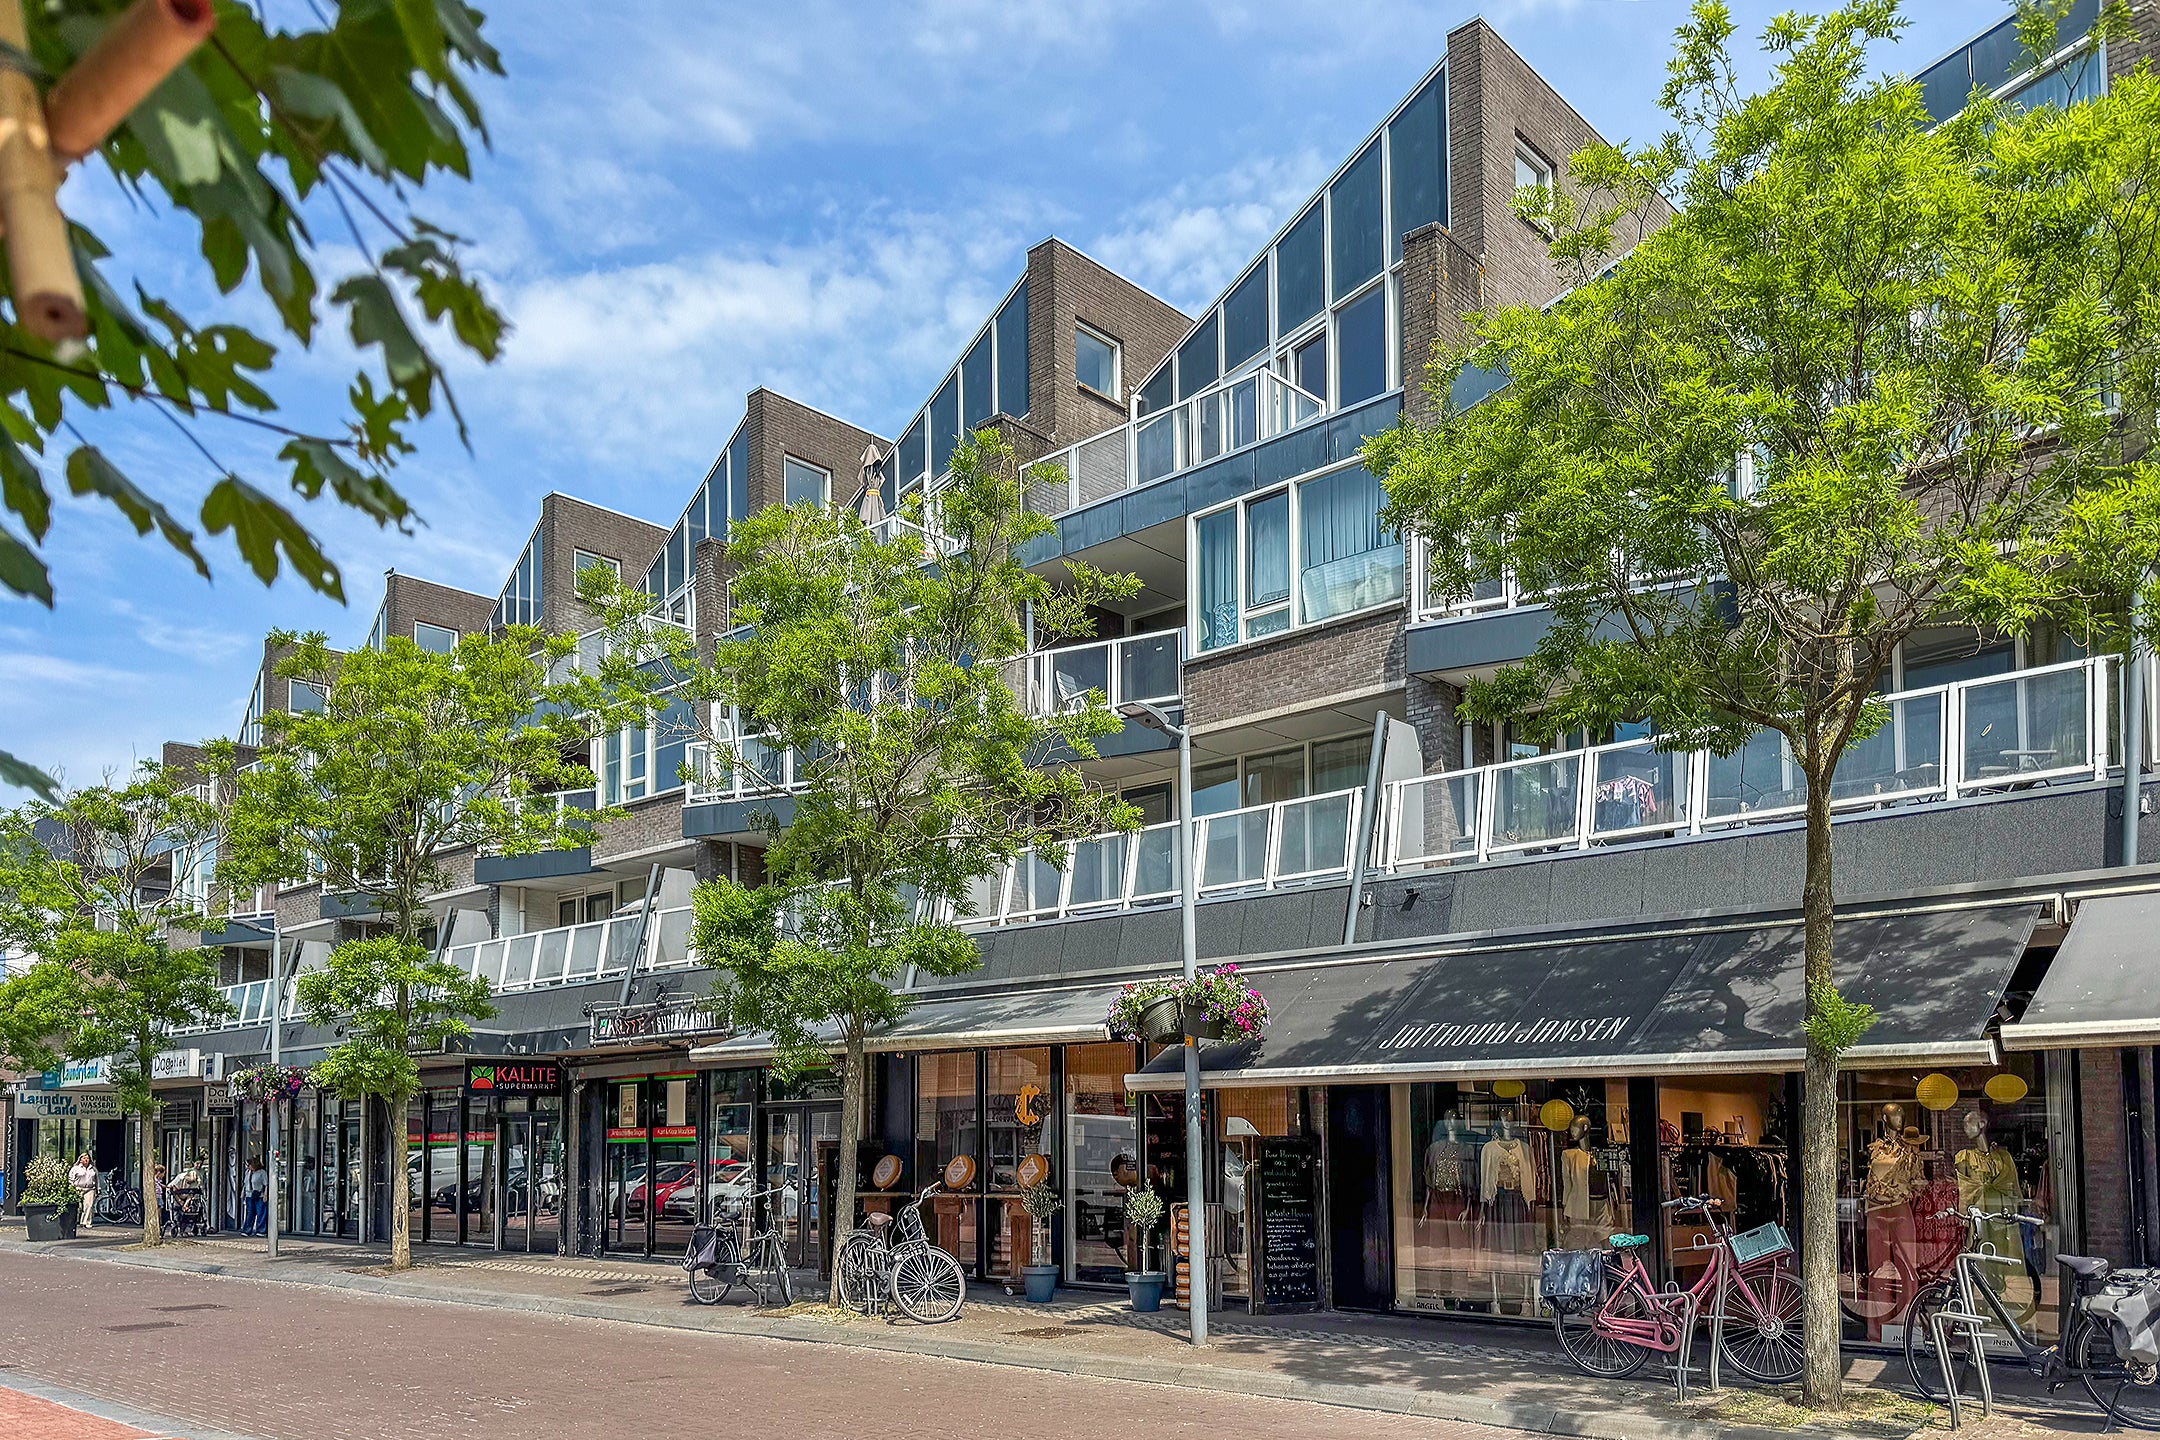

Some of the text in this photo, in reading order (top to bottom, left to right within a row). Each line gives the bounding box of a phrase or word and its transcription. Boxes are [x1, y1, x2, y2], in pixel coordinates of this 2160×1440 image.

[1378, 1016, 1630, 1049] JUFFROUW JANSEN
[496, 1066, 556, 1082] KALITE
[20, 1093, 73, 1107] Laundry
[47, 1103, 77, 1116] Land
[1992, 1339, 2013, 1347] JNSN
